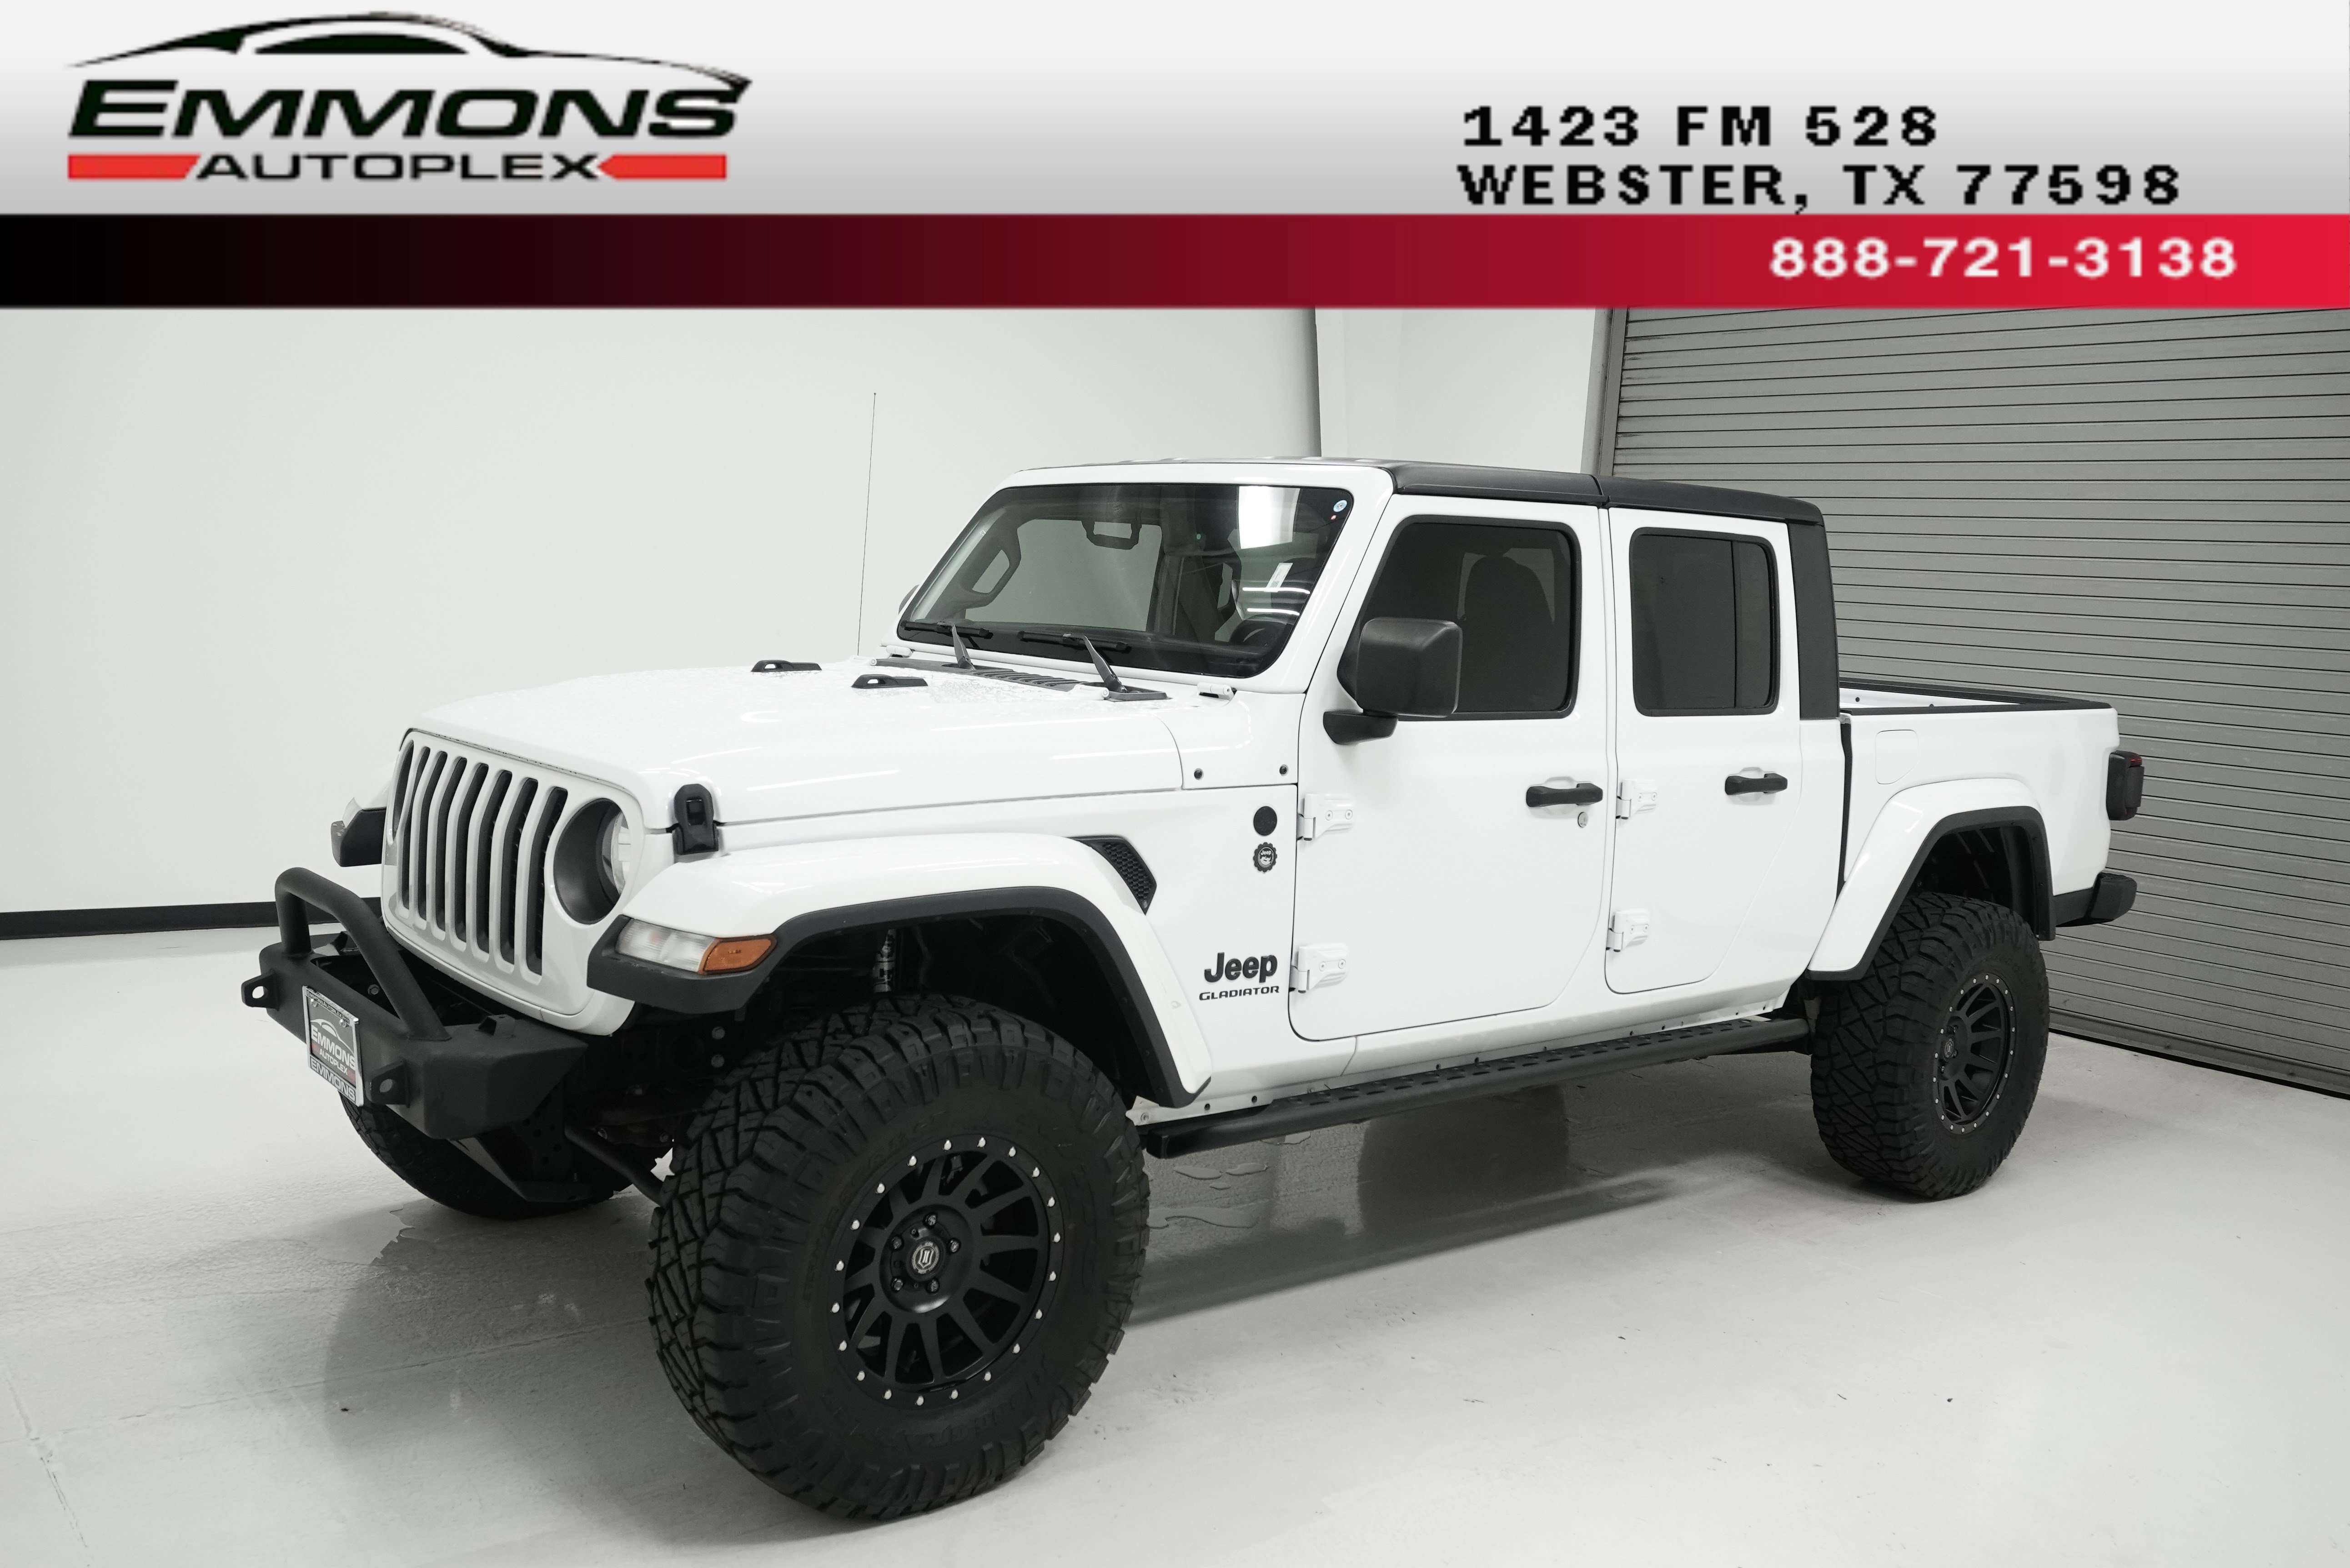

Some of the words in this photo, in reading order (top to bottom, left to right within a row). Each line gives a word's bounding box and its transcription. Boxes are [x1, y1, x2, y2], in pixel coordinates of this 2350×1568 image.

[1204, 952, 1278, 983] Jeep
[1199, 985, 1280, 1001] GLADIATOR
[311, 1025, 356, 1069] EMMONS
[319, 1048, 349, 1076] AUTOPLEX
[310, 1060, 356, 1101] EMMONS
